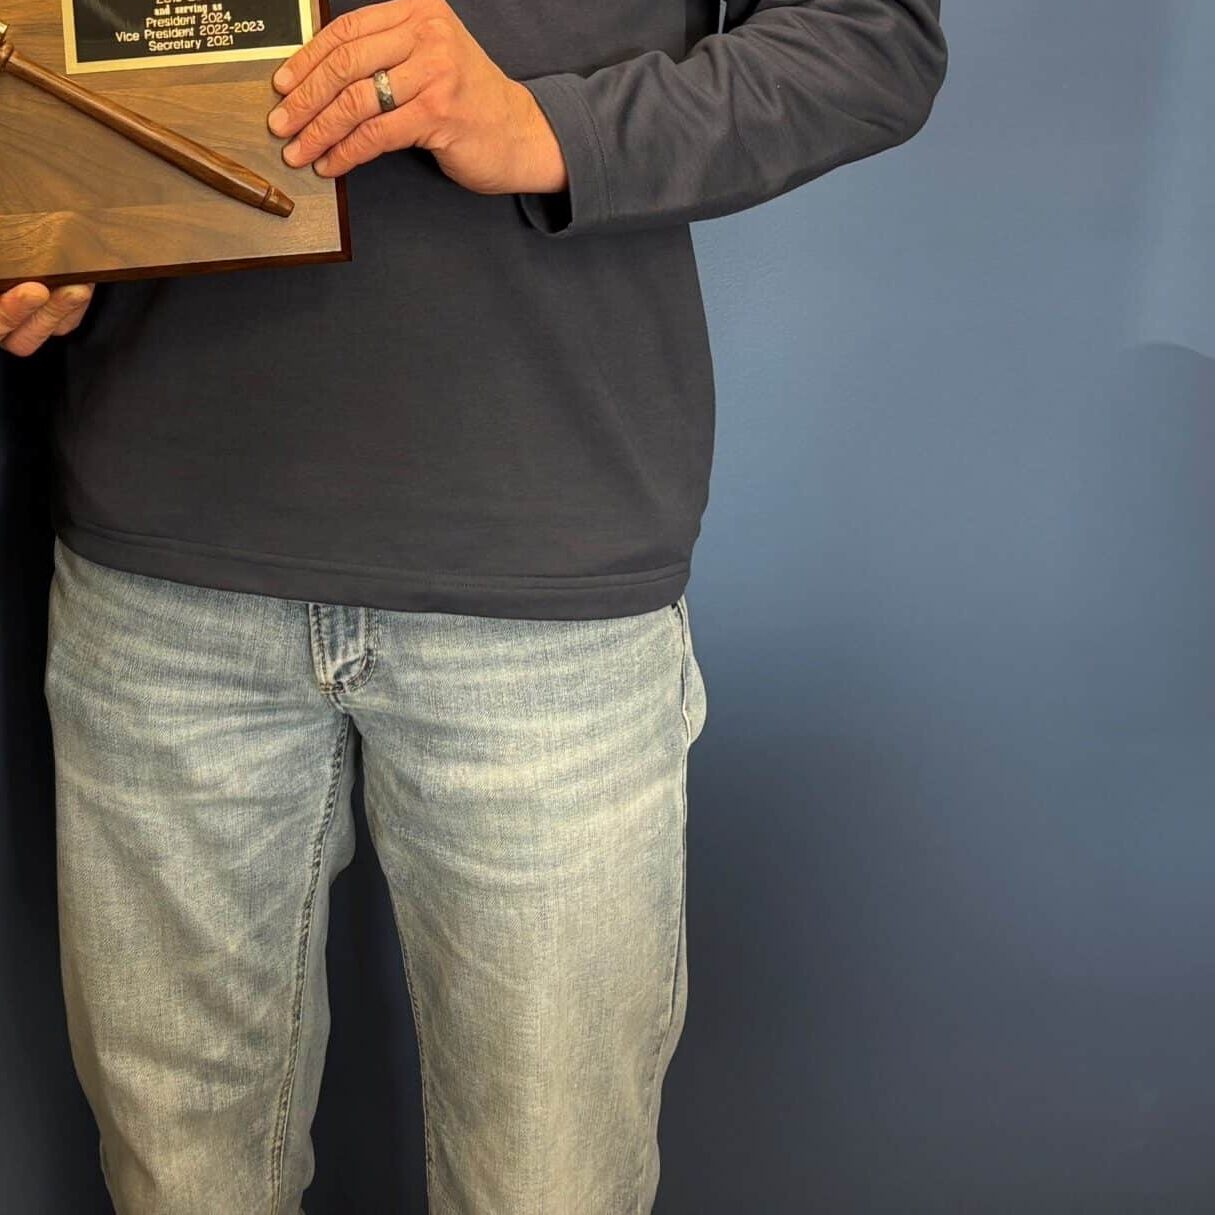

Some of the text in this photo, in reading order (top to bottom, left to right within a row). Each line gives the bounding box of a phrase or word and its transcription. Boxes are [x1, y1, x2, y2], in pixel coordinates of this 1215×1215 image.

[154, 3, 222, 15] and serving as
[146, 11, 231, 28] President 2024
[115, 20, 265, 42] Vice President 2022-2023
[148, 35, 234, 51] Secretary 2021
